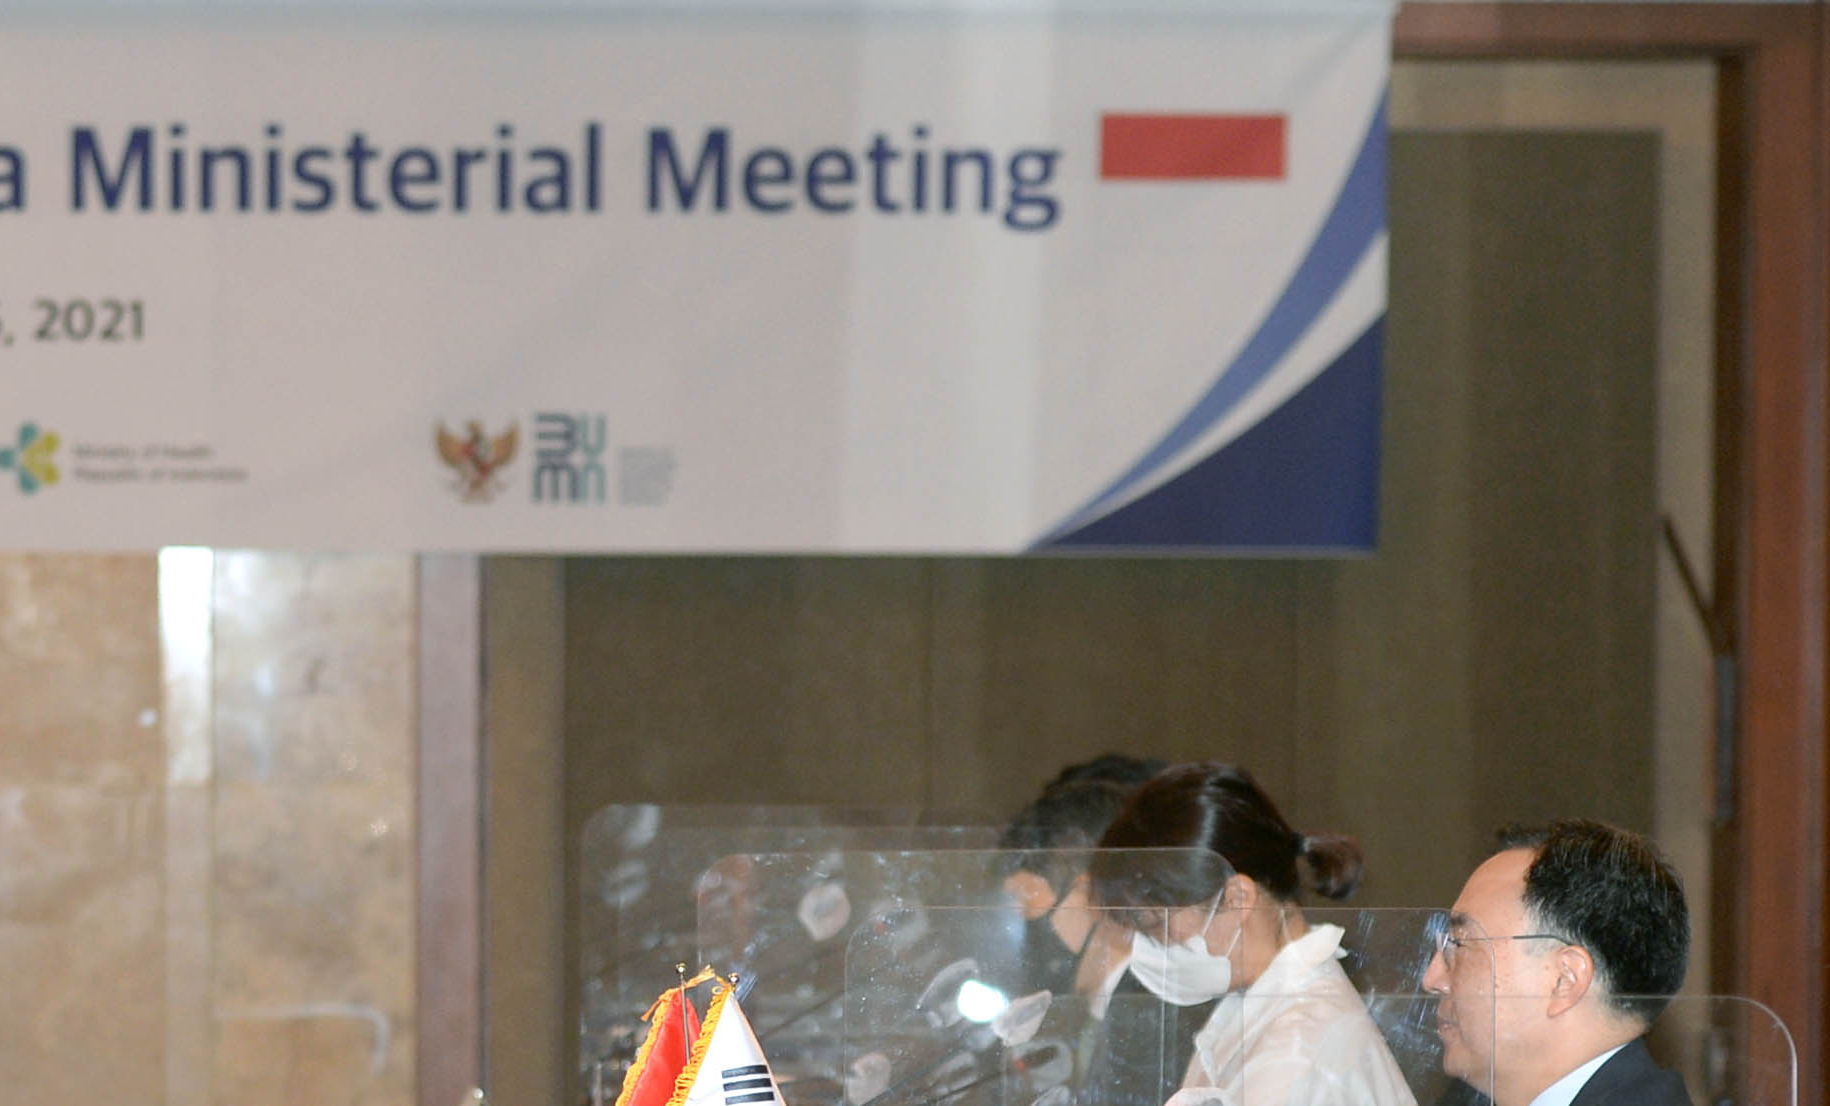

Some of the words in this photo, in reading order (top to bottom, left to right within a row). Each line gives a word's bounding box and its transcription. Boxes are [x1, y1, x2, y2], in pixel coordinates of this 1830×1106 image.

[69, 120, 603, 215] Ministerial
[645, 124, 1063, 233] Meeting
[33, 298, 146, 343] 2021
